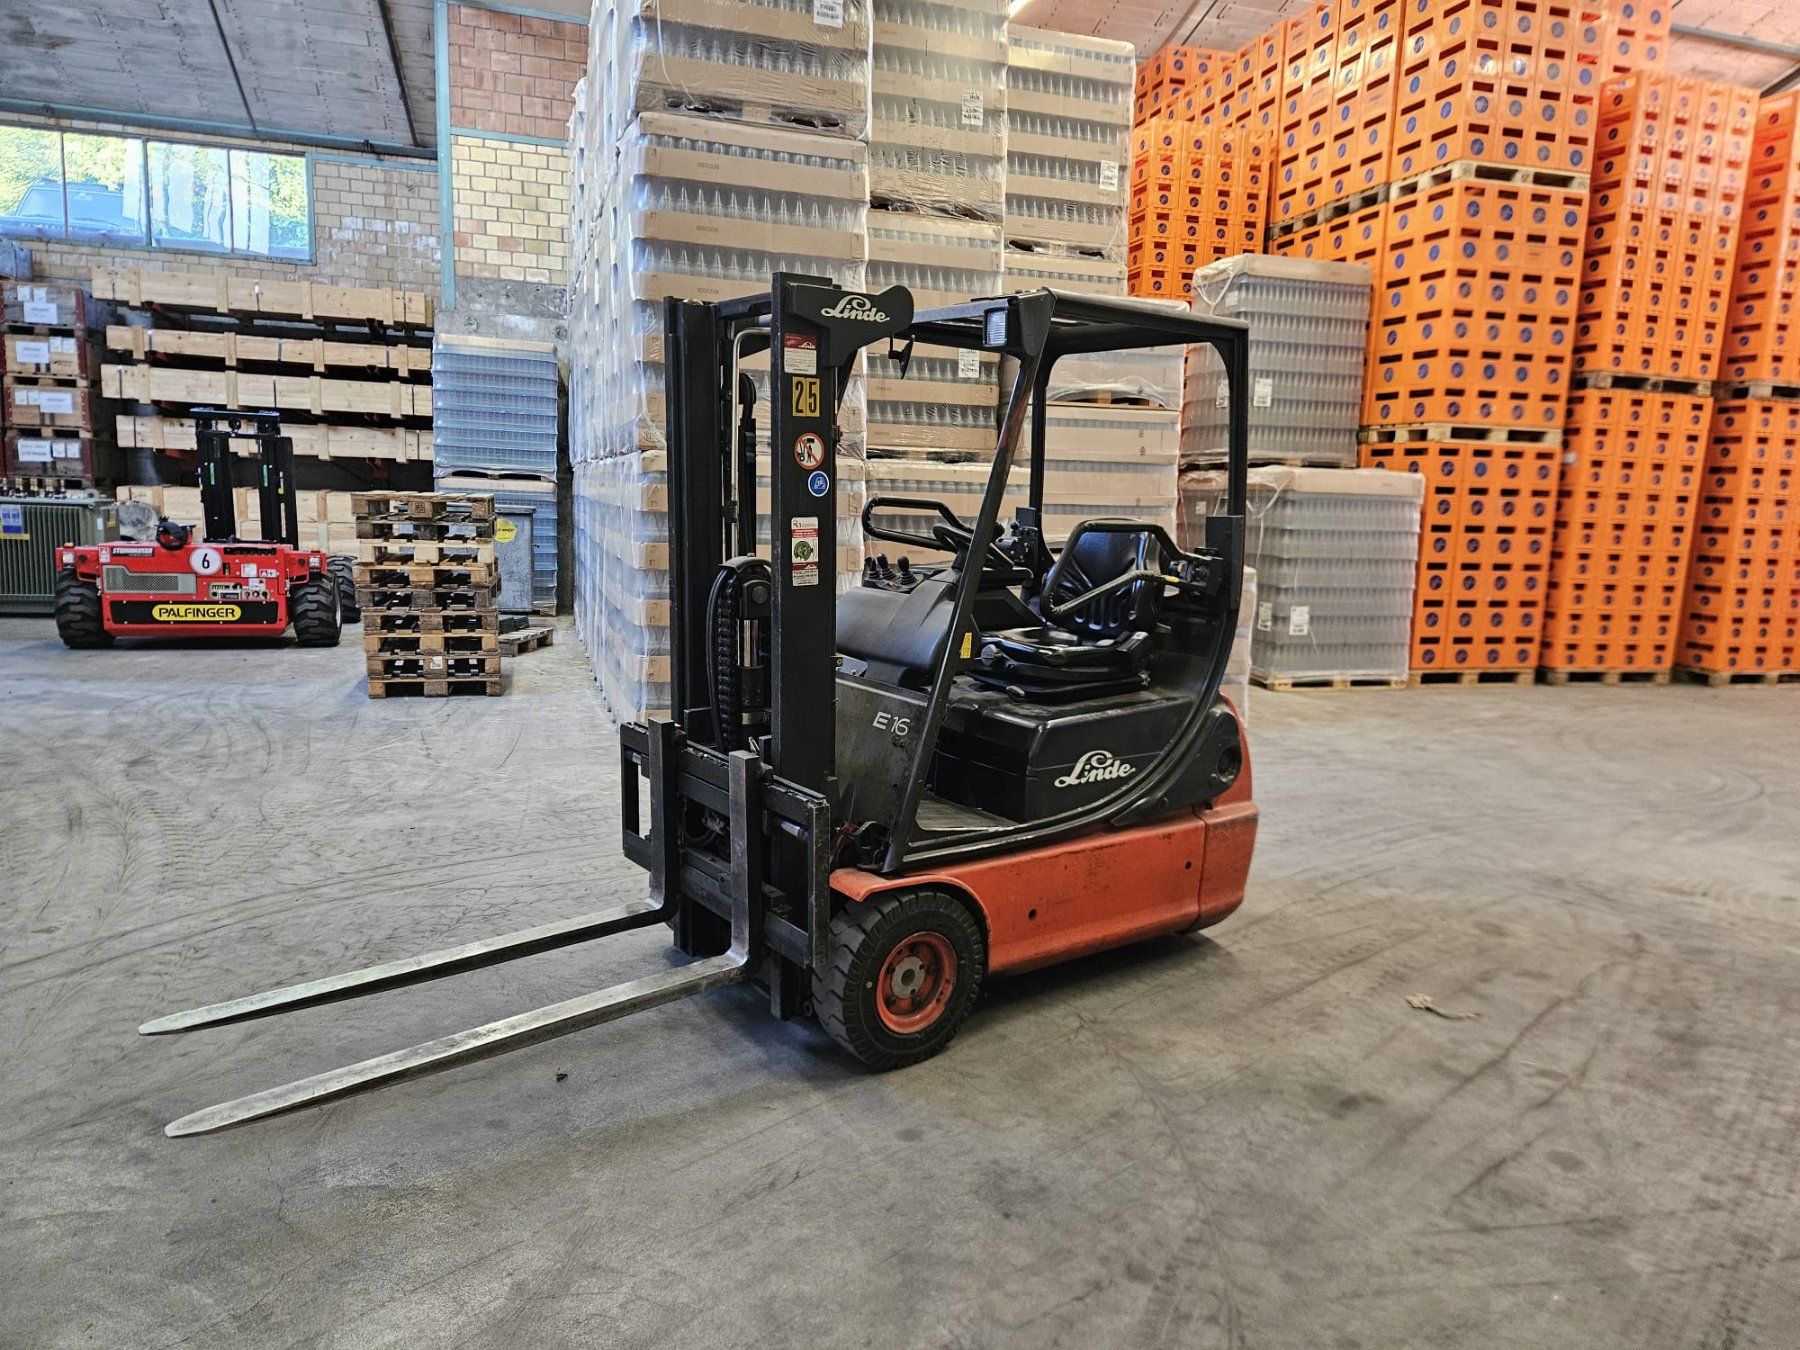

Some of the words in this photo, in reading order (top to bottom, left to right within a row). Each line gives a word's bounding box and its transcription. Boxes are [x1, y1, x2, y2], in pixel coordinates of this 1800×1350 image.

[820, 294, 891, 323] Linde
[795, 380, 817, 414] 25
[202, 553, 210, 569] 6
[158, 607, 236, 618] PALFINGER
[1054, 750, 1136, 788] Linde
